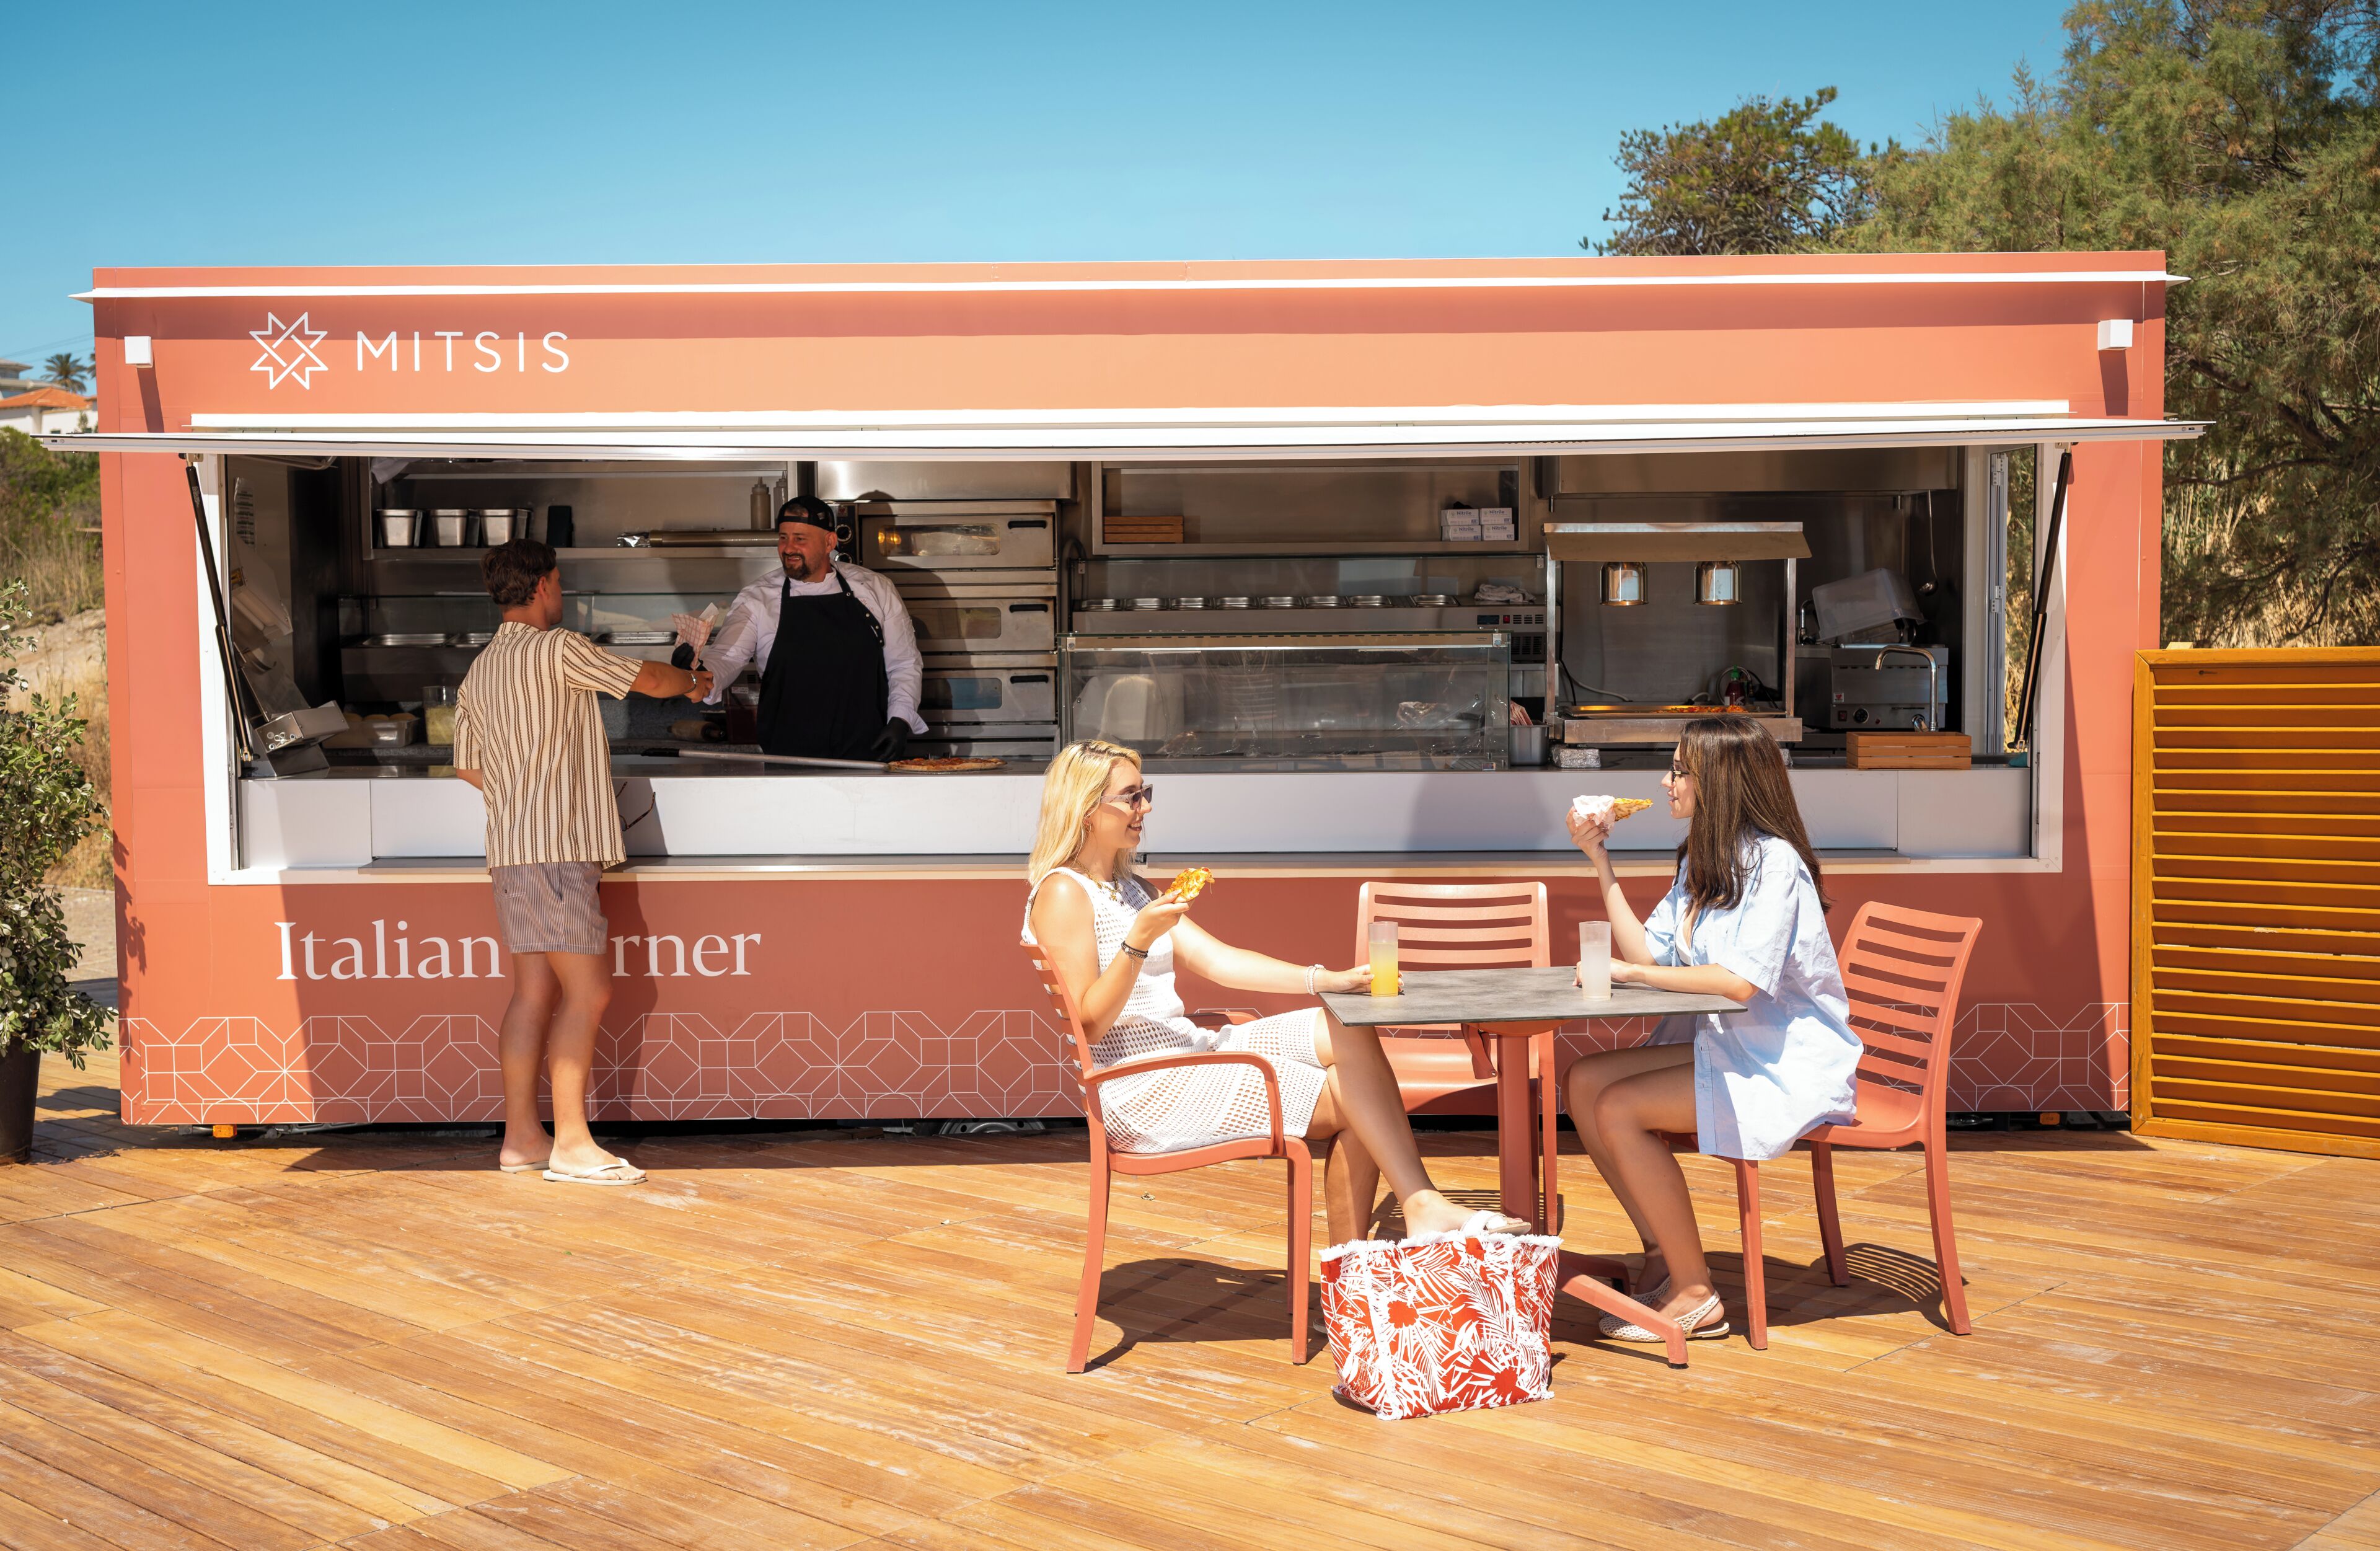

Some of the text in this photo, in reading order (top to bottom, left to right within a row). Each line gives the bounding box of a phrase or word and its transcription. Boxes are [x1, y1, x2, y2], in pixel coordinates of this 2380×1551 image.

[356, 331, 569, 372] MITSIS
[275, 918, 762, 980] Italian rner
